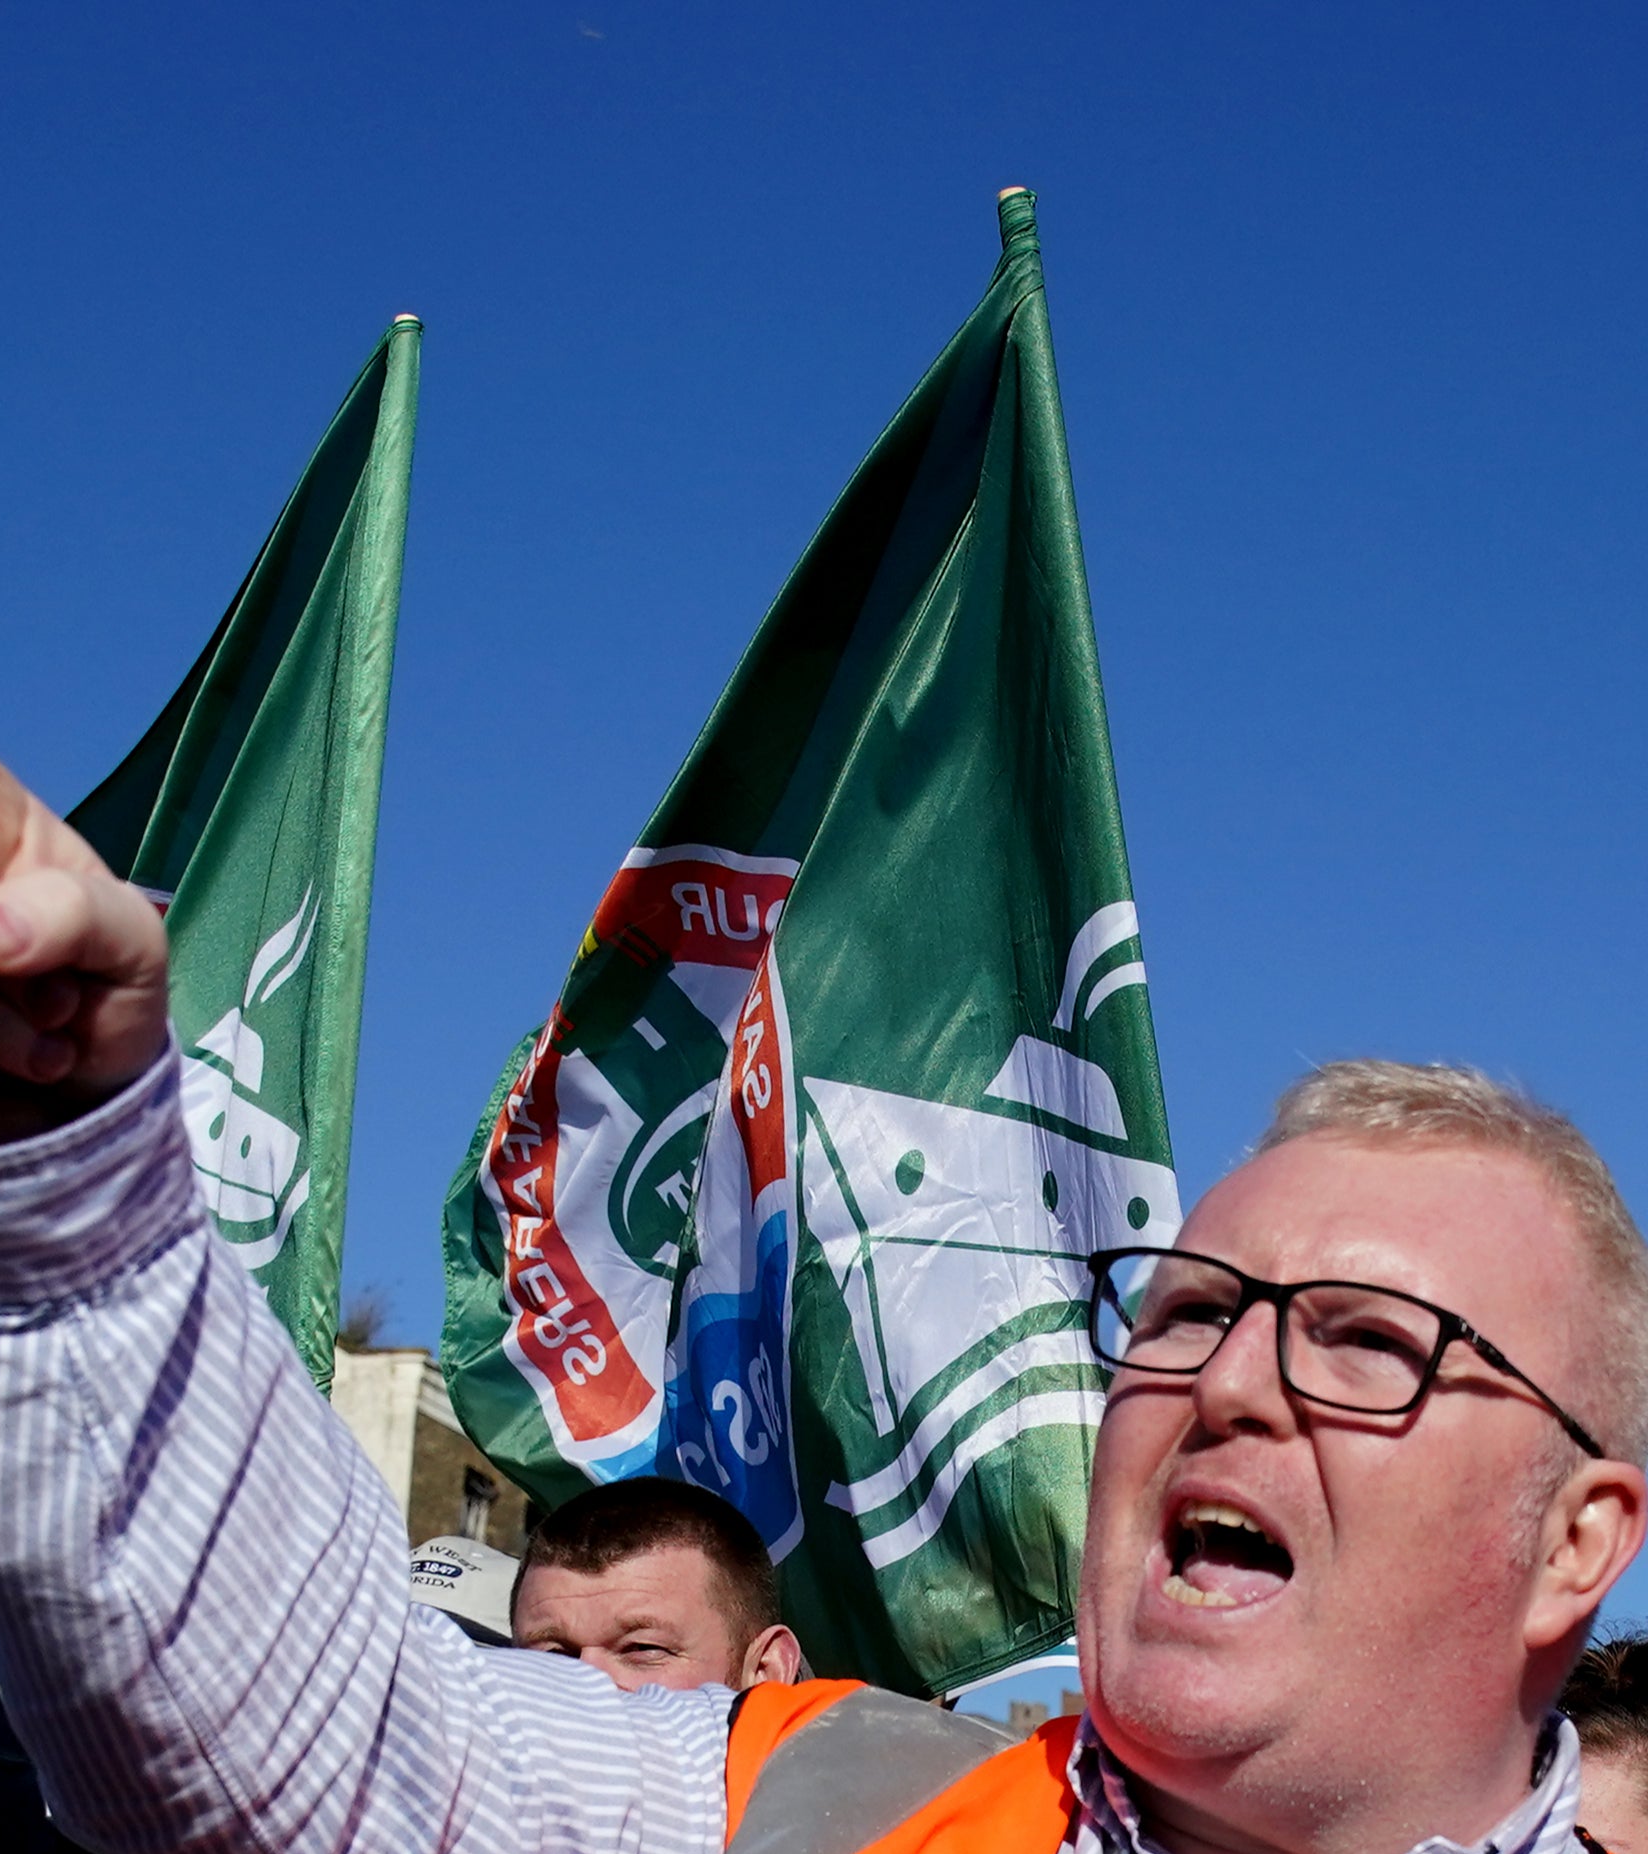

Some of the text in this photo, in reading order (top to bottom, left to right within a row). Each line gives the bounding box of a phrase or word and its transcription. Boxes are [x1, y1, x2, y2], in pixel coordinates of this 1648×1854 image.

[429, 1545, 482, 1572] WEST
[422, 1561, 456, 1575] 1847
[411, 1576, 456, 1589] RIDA
